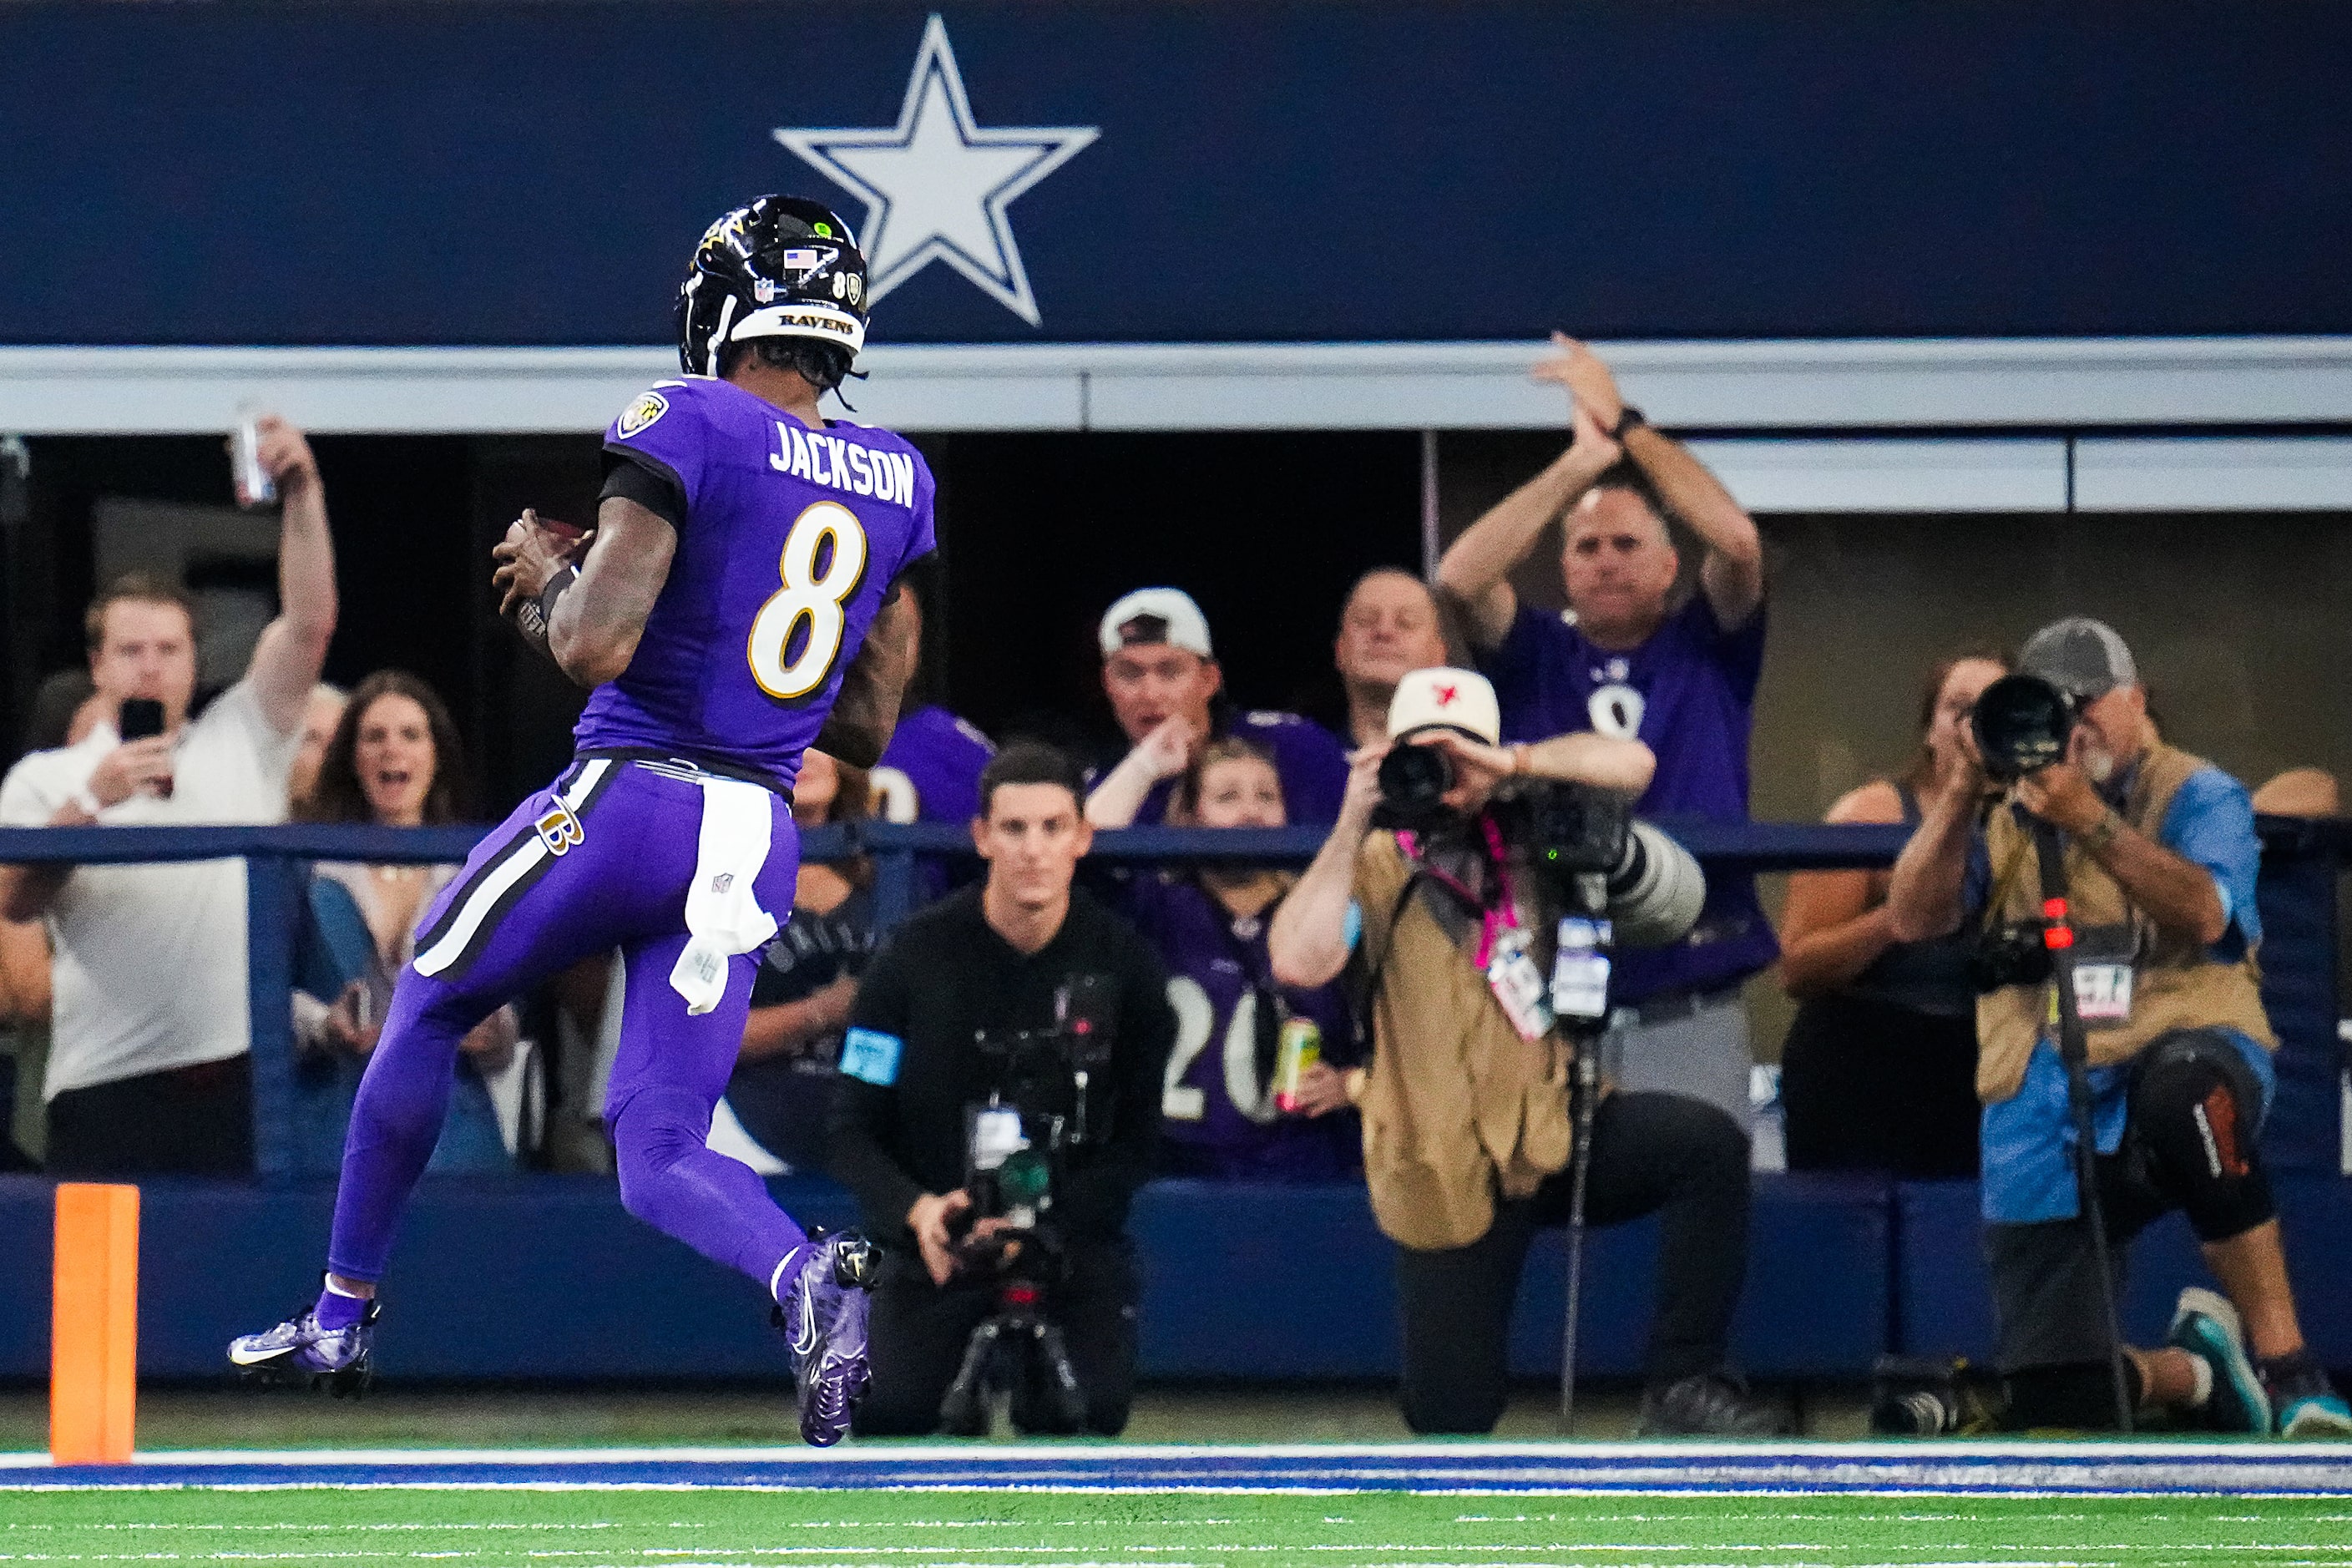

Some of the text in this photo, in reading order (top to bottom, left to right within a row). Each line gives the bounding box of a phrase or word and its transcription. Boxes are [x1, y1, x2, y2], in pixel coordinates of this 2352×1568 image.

[778, 315, 854, 335] RAVENS
[770, 421, 914, 508] JACKSON
[747, 500, 867, 699] 8
